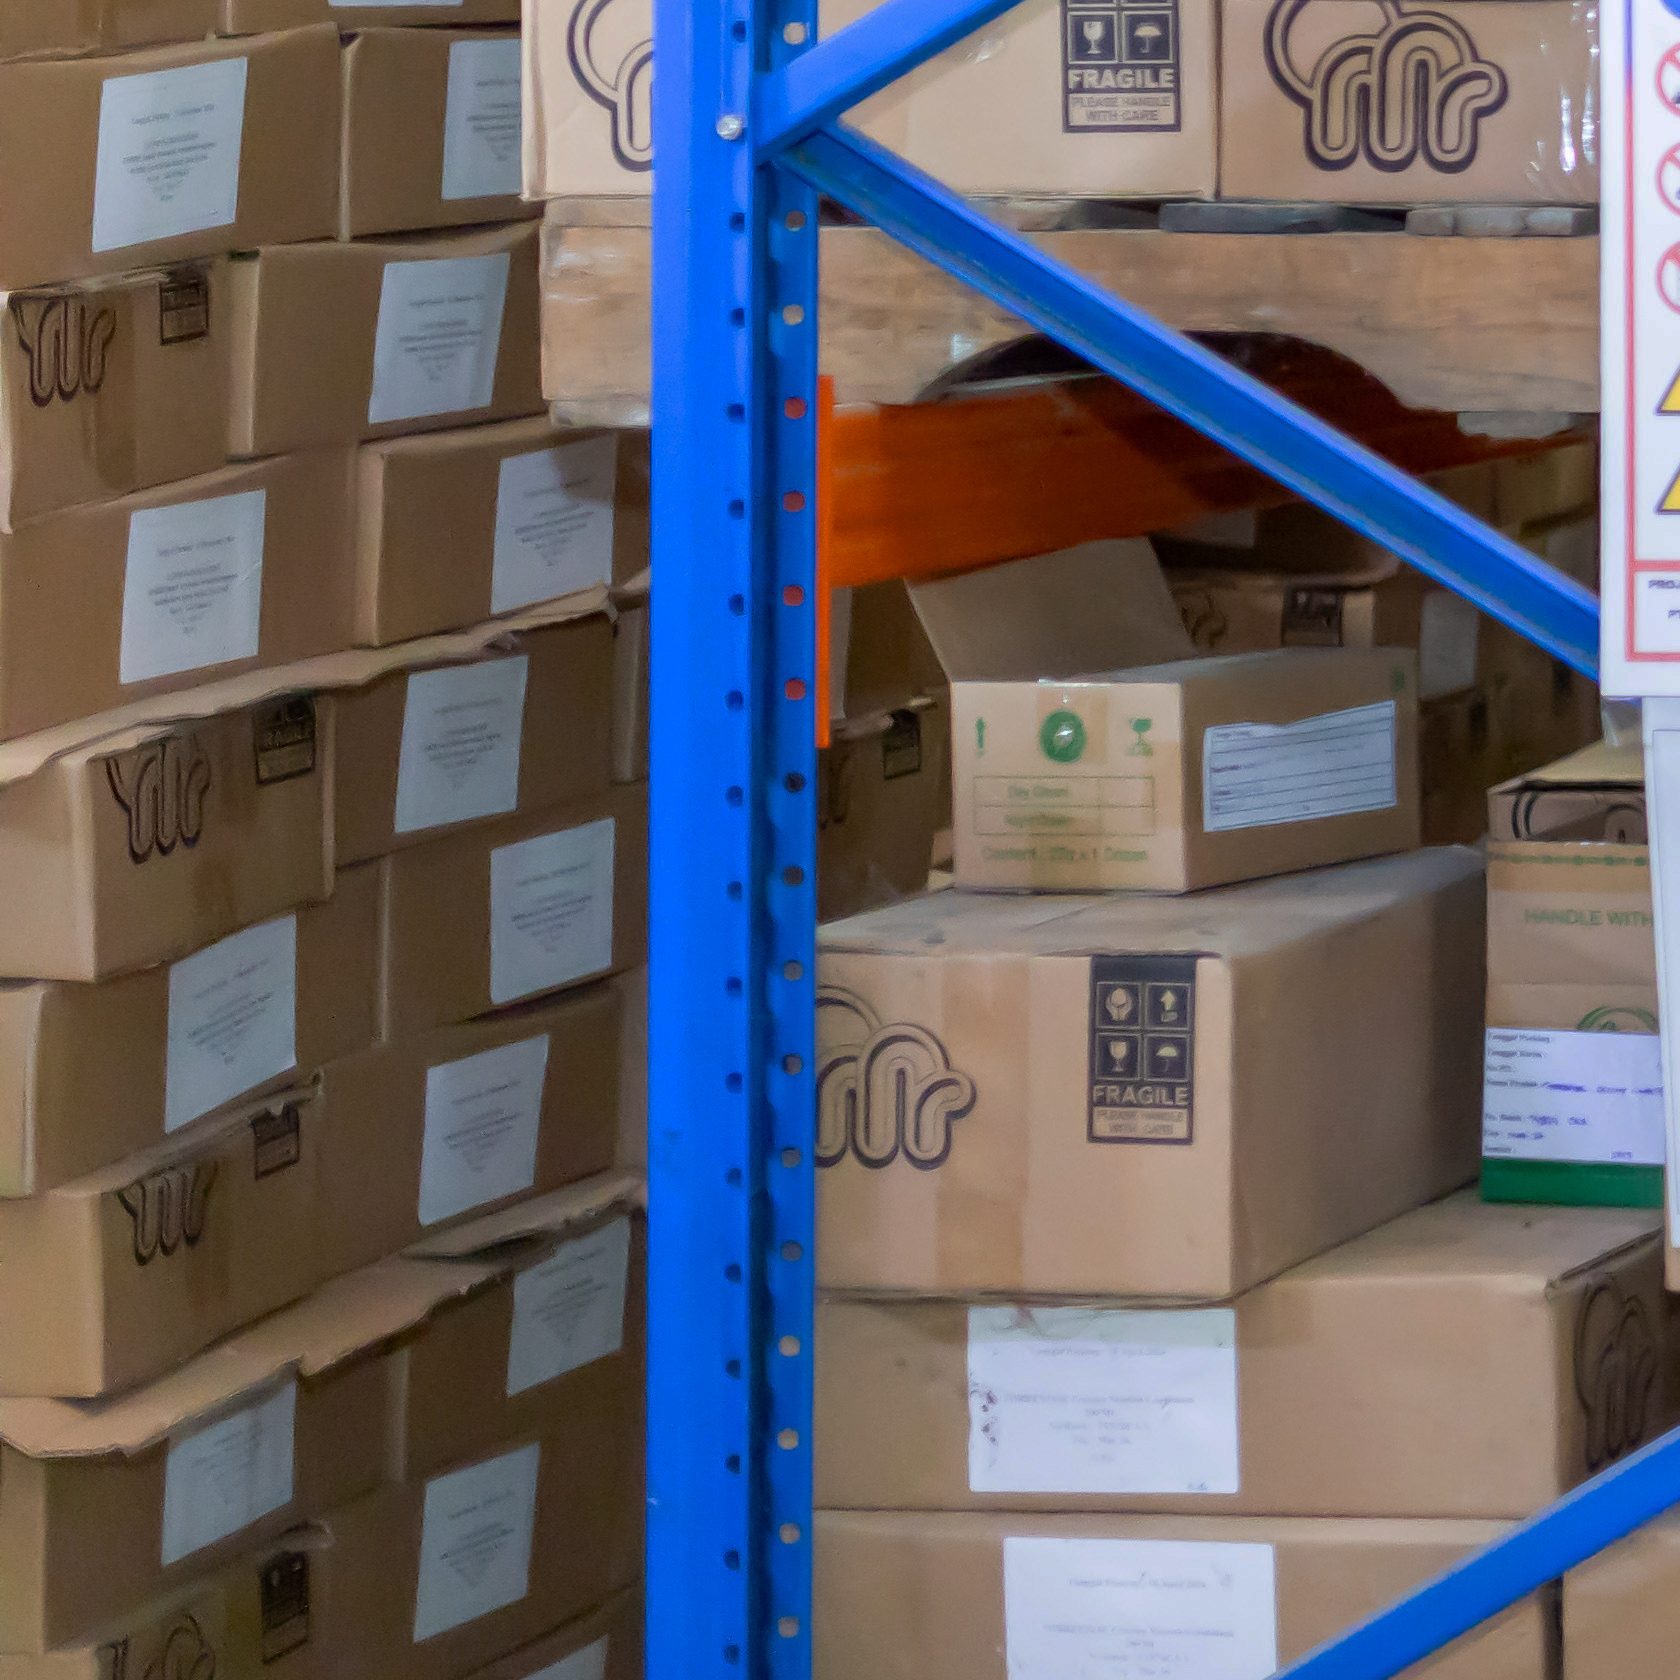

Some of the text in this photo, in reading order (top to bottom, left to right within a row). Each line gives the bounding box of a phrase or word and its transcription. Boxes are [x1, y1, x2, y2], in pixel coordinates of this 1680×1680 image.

[1067, 69, 1175, 89] FRAGILE
[1525, 908, 1603, 926] HANDLE
[1093, 1084, 1189, 1106] FRAGILE
